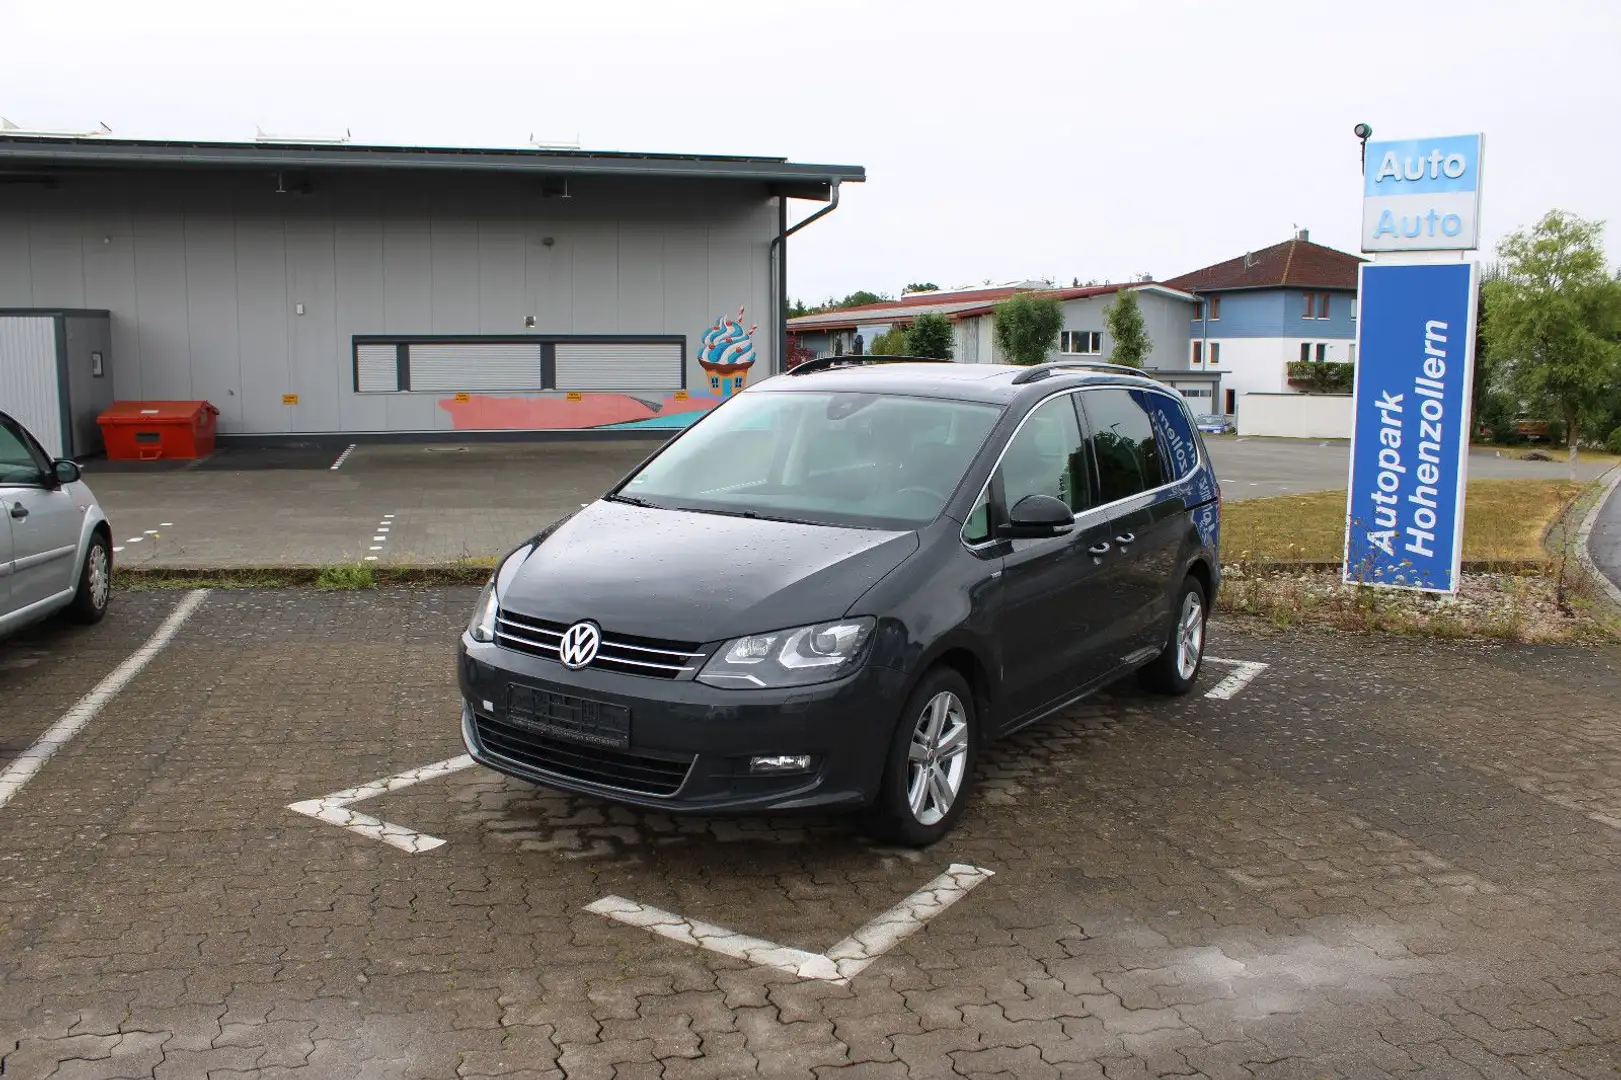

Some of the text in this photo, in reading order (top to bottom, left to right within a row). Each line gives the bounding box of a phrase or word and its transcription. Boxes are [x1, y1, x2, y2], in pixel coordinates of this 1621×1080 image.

[1375, 149, 1467, 183] Auto
[1372, 207, 1462, 239] Auto
[1405, 319, 1449, 558] Hohenzollern
[1366, 389, 1407, 557] Autopark
[560, 622, 600, 669] VW
